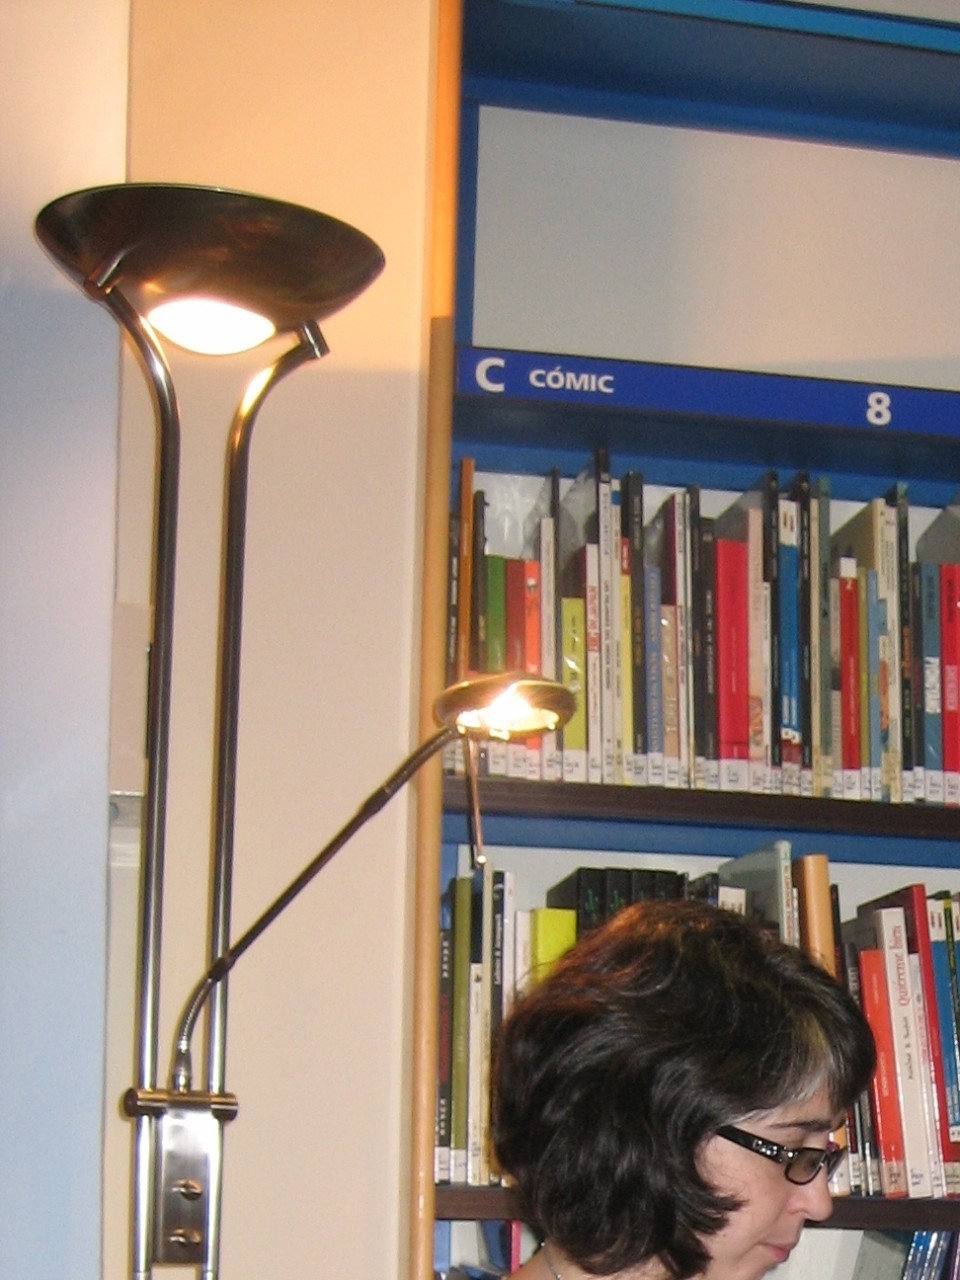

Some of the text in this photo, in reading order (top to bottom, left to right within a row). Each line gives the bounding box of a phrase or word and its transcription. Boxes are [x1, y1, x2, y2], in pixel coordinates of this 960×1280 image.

[475, 356, 614, 394] C CÓMIC
[866, 392, 893, 425] 8
[889, 926, 903, 949] bien
